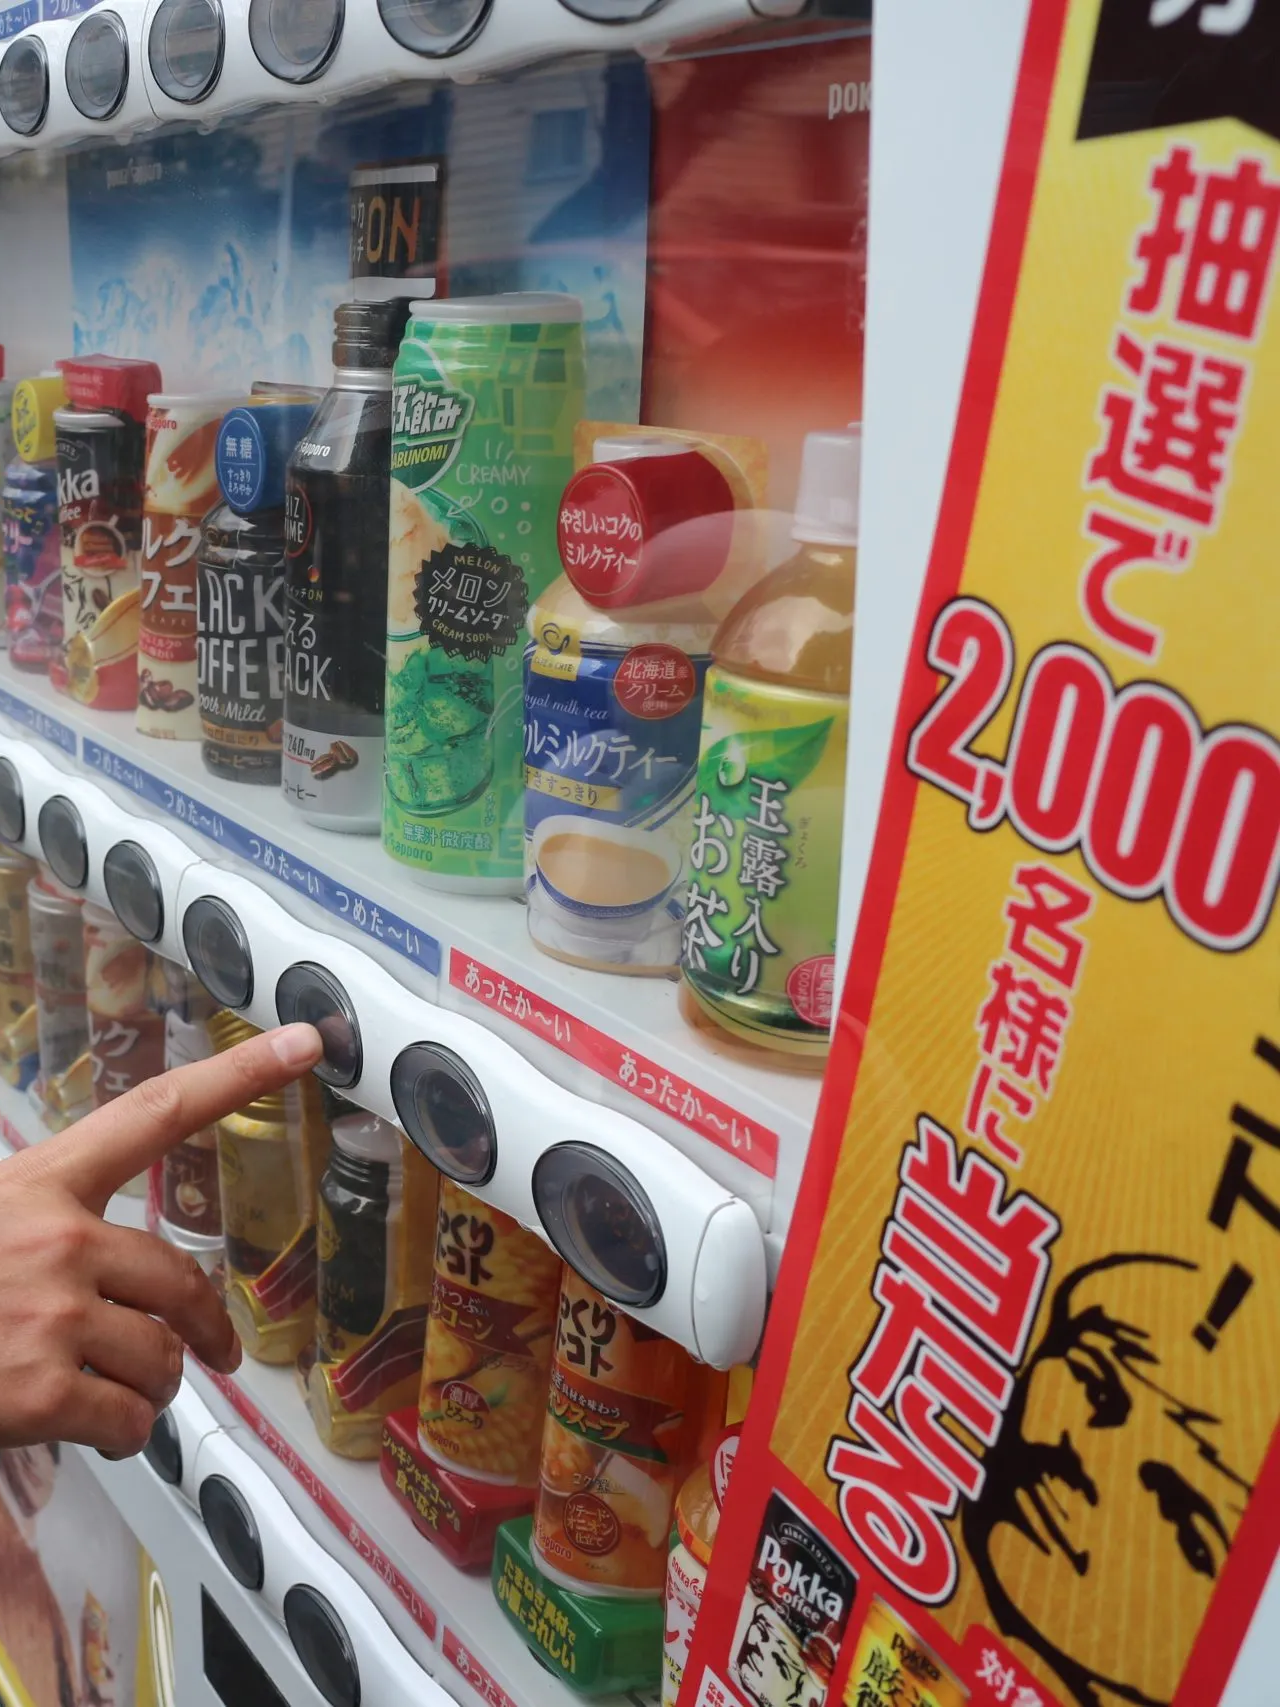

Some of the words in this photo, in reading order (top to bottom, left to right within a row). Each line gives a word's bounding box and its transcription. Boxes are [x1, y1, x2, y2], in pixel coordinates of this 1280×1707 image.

[1080, 143, 1280, 665] 抽選で
[225, 435, 253, 459] 無糖
[455, 462, 532, 486] CREAMY
[560, 507, 642, 541] やさしいコクの
[453, 555, 502, 575] MELON
[565, 541, 638, 573] ミルクティー
[427, 595, 510, 631] クリームソーダ
[428, 566, 512, 608] メロン
[552, 702, 581, 716] milk
[583, 709, 609, 721] tea
[625, 682, 686, 701] クリーム
[907, 592, 1280, 957] 2,000
[163, 789, 224, 838] つめた〜い
[249, 838, 320, 895] つめた〜い
[681, 793, 735, 973] お茶
[730, 774, 790, 997] 玉露入り
[335, 890, 421, 956] つめた〜い
[464, 961, 571, 1043] あったか〜い
[962, 861, 1096, 1166] 名様に
[617, 1052, 752, 1151] あったか〜い
[826, 1114, 1062, 1608] 当たる
[757, 1535, 844, 1622] Pokka
[772, 1582, 821, 1624] Coffee
